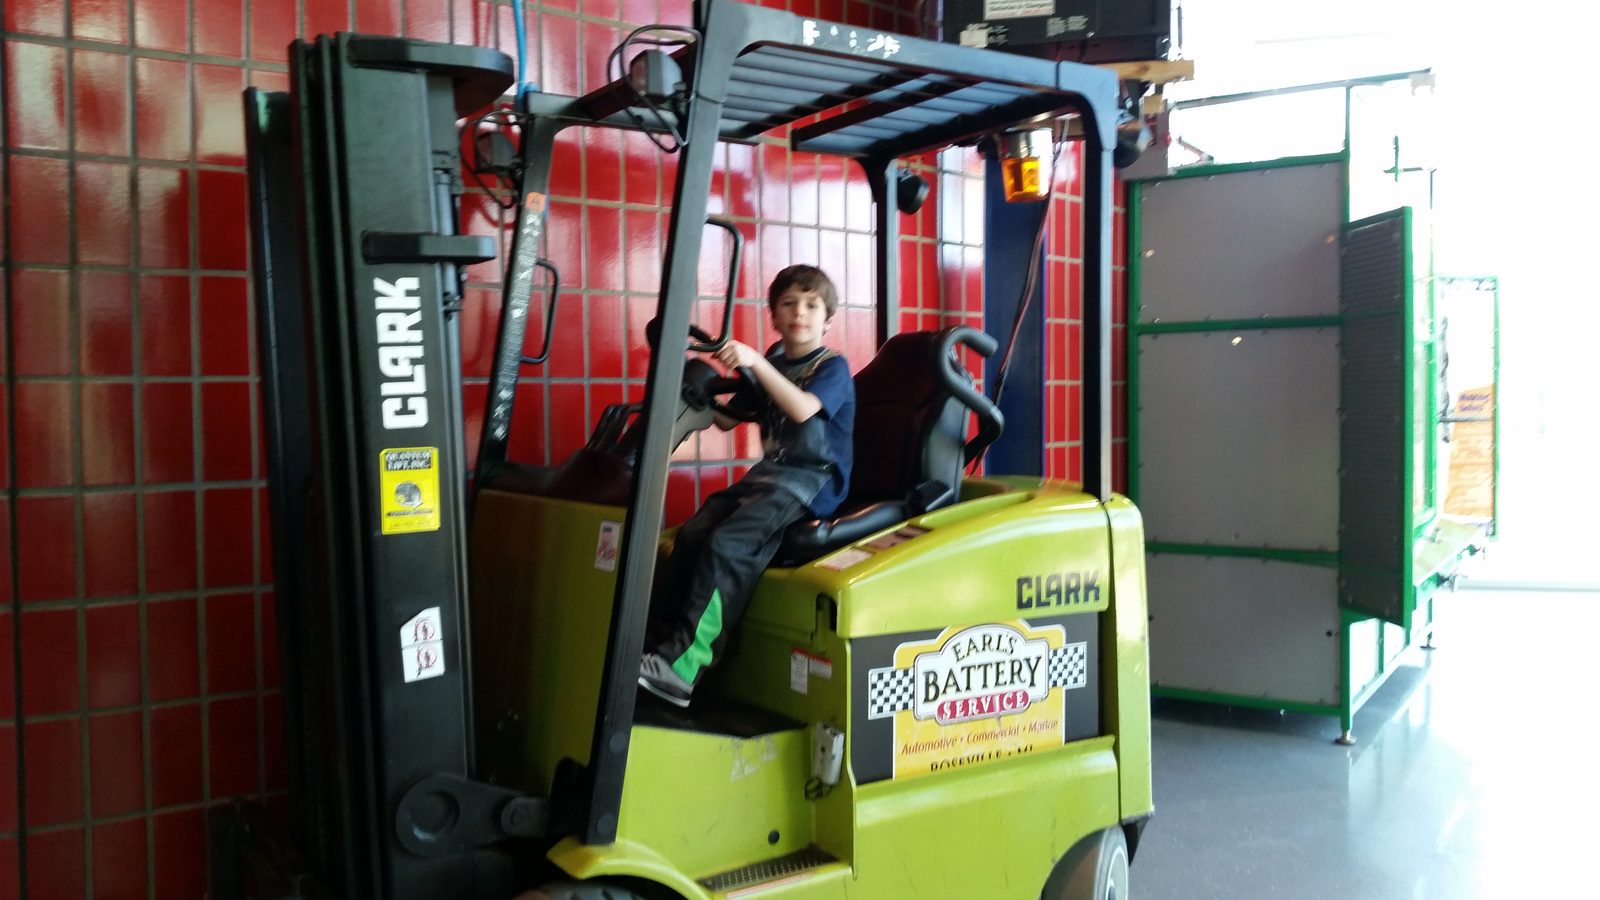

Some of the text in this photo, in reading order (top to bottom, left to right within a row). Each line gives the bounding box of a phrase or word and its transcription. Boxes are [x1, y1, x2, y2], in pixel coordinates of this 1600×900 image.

[373, 277, 429, 429] CLARK
[1016, 570, 1100, 610] CLARK
[952, 632, 1017, 662] EARL'S
[922, 656, 1041, 704] BATTERY
[941, 692, 1025, 719] SERVICE
[901, 719, 1058, 756] Automotive Commercial Marine
